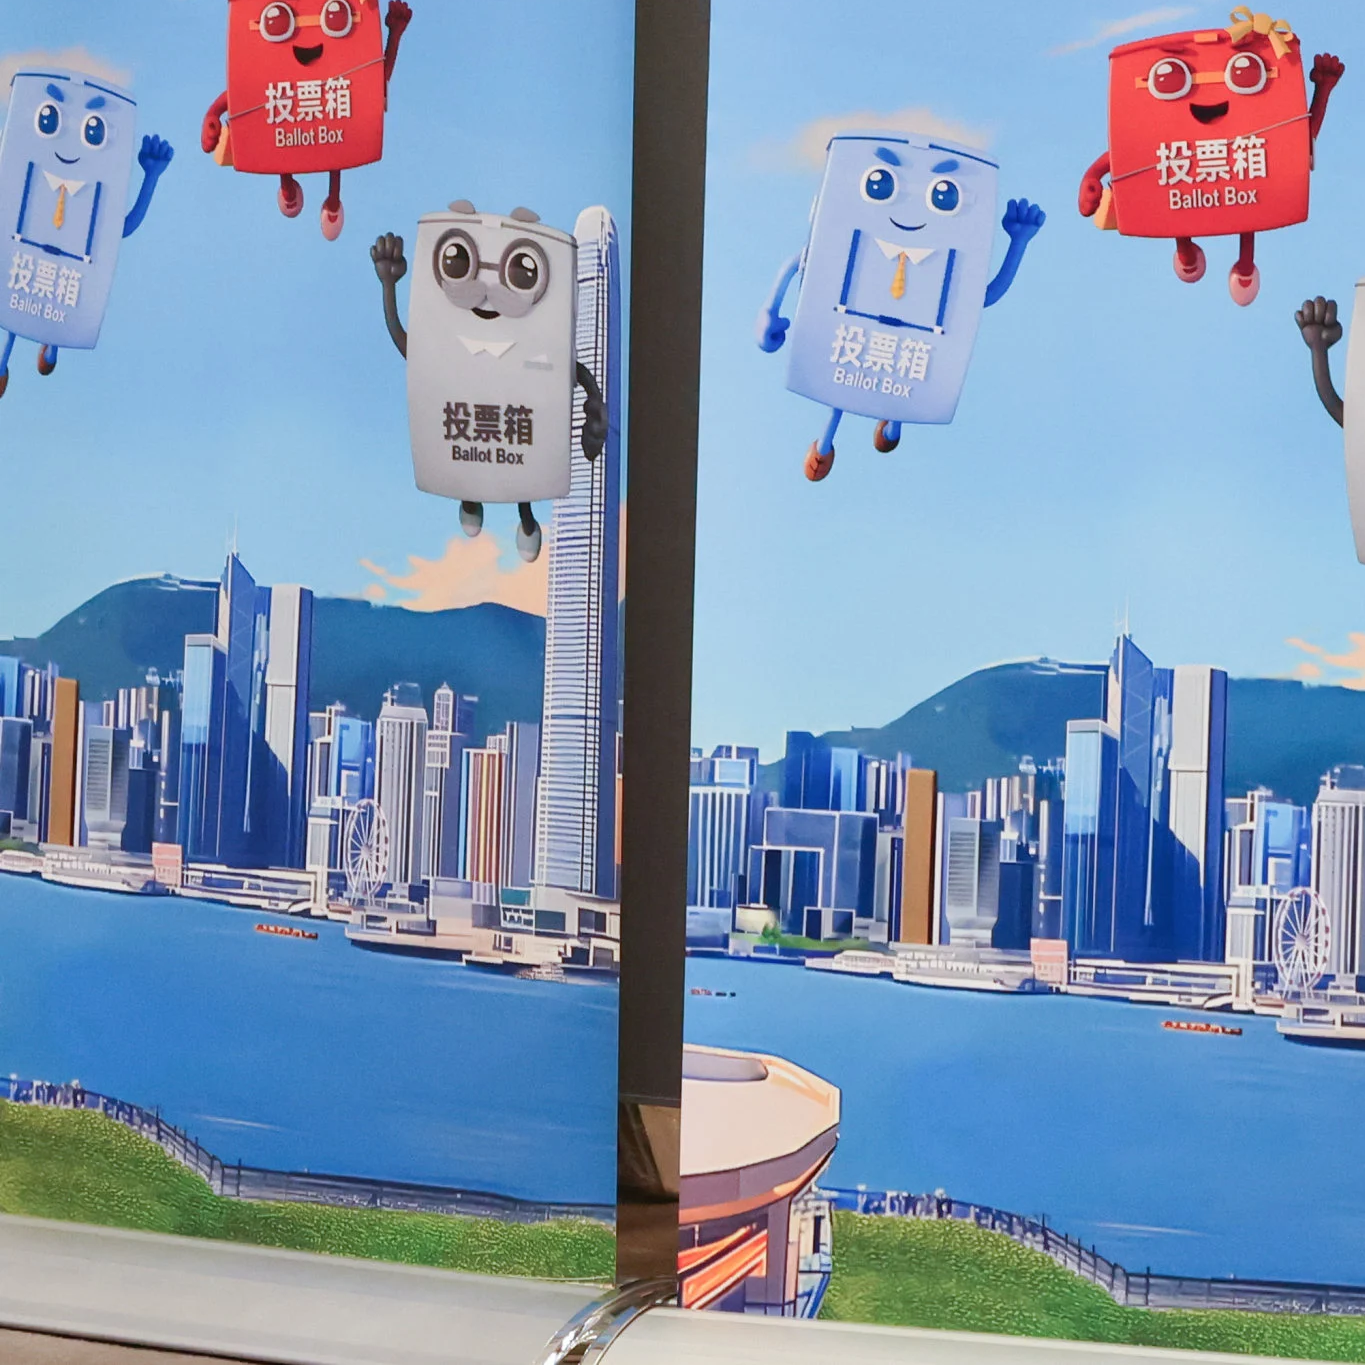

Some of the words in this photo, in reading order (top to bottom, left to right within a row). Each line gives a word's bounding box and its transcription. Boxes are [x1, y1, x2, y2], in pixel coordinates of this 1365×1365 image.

[265, 76, 351, 124] 投票箱
[275, 128, 315, 147] Ballot
[318, 126, 343, 143] Box
[1156, 134, 1267, 186] 投票箱
[1169, 189, 1221, 210] Ballot
[1224, 187, 1257, 206] Box
[7, 250, 82, 308] 投票箱
[9, 293, 43, 317] Ballot
[43, 302, 67, 324] Box
[830, 323, 931, 381] 投票箱
[834, 367, 878, 391] Ballot
[882, 377, 912, 398] Box
[442, 401, 534, 446] 投票箱
[451, 444, 493, 464] Ballot
[495, 447, 525, 466] Box
